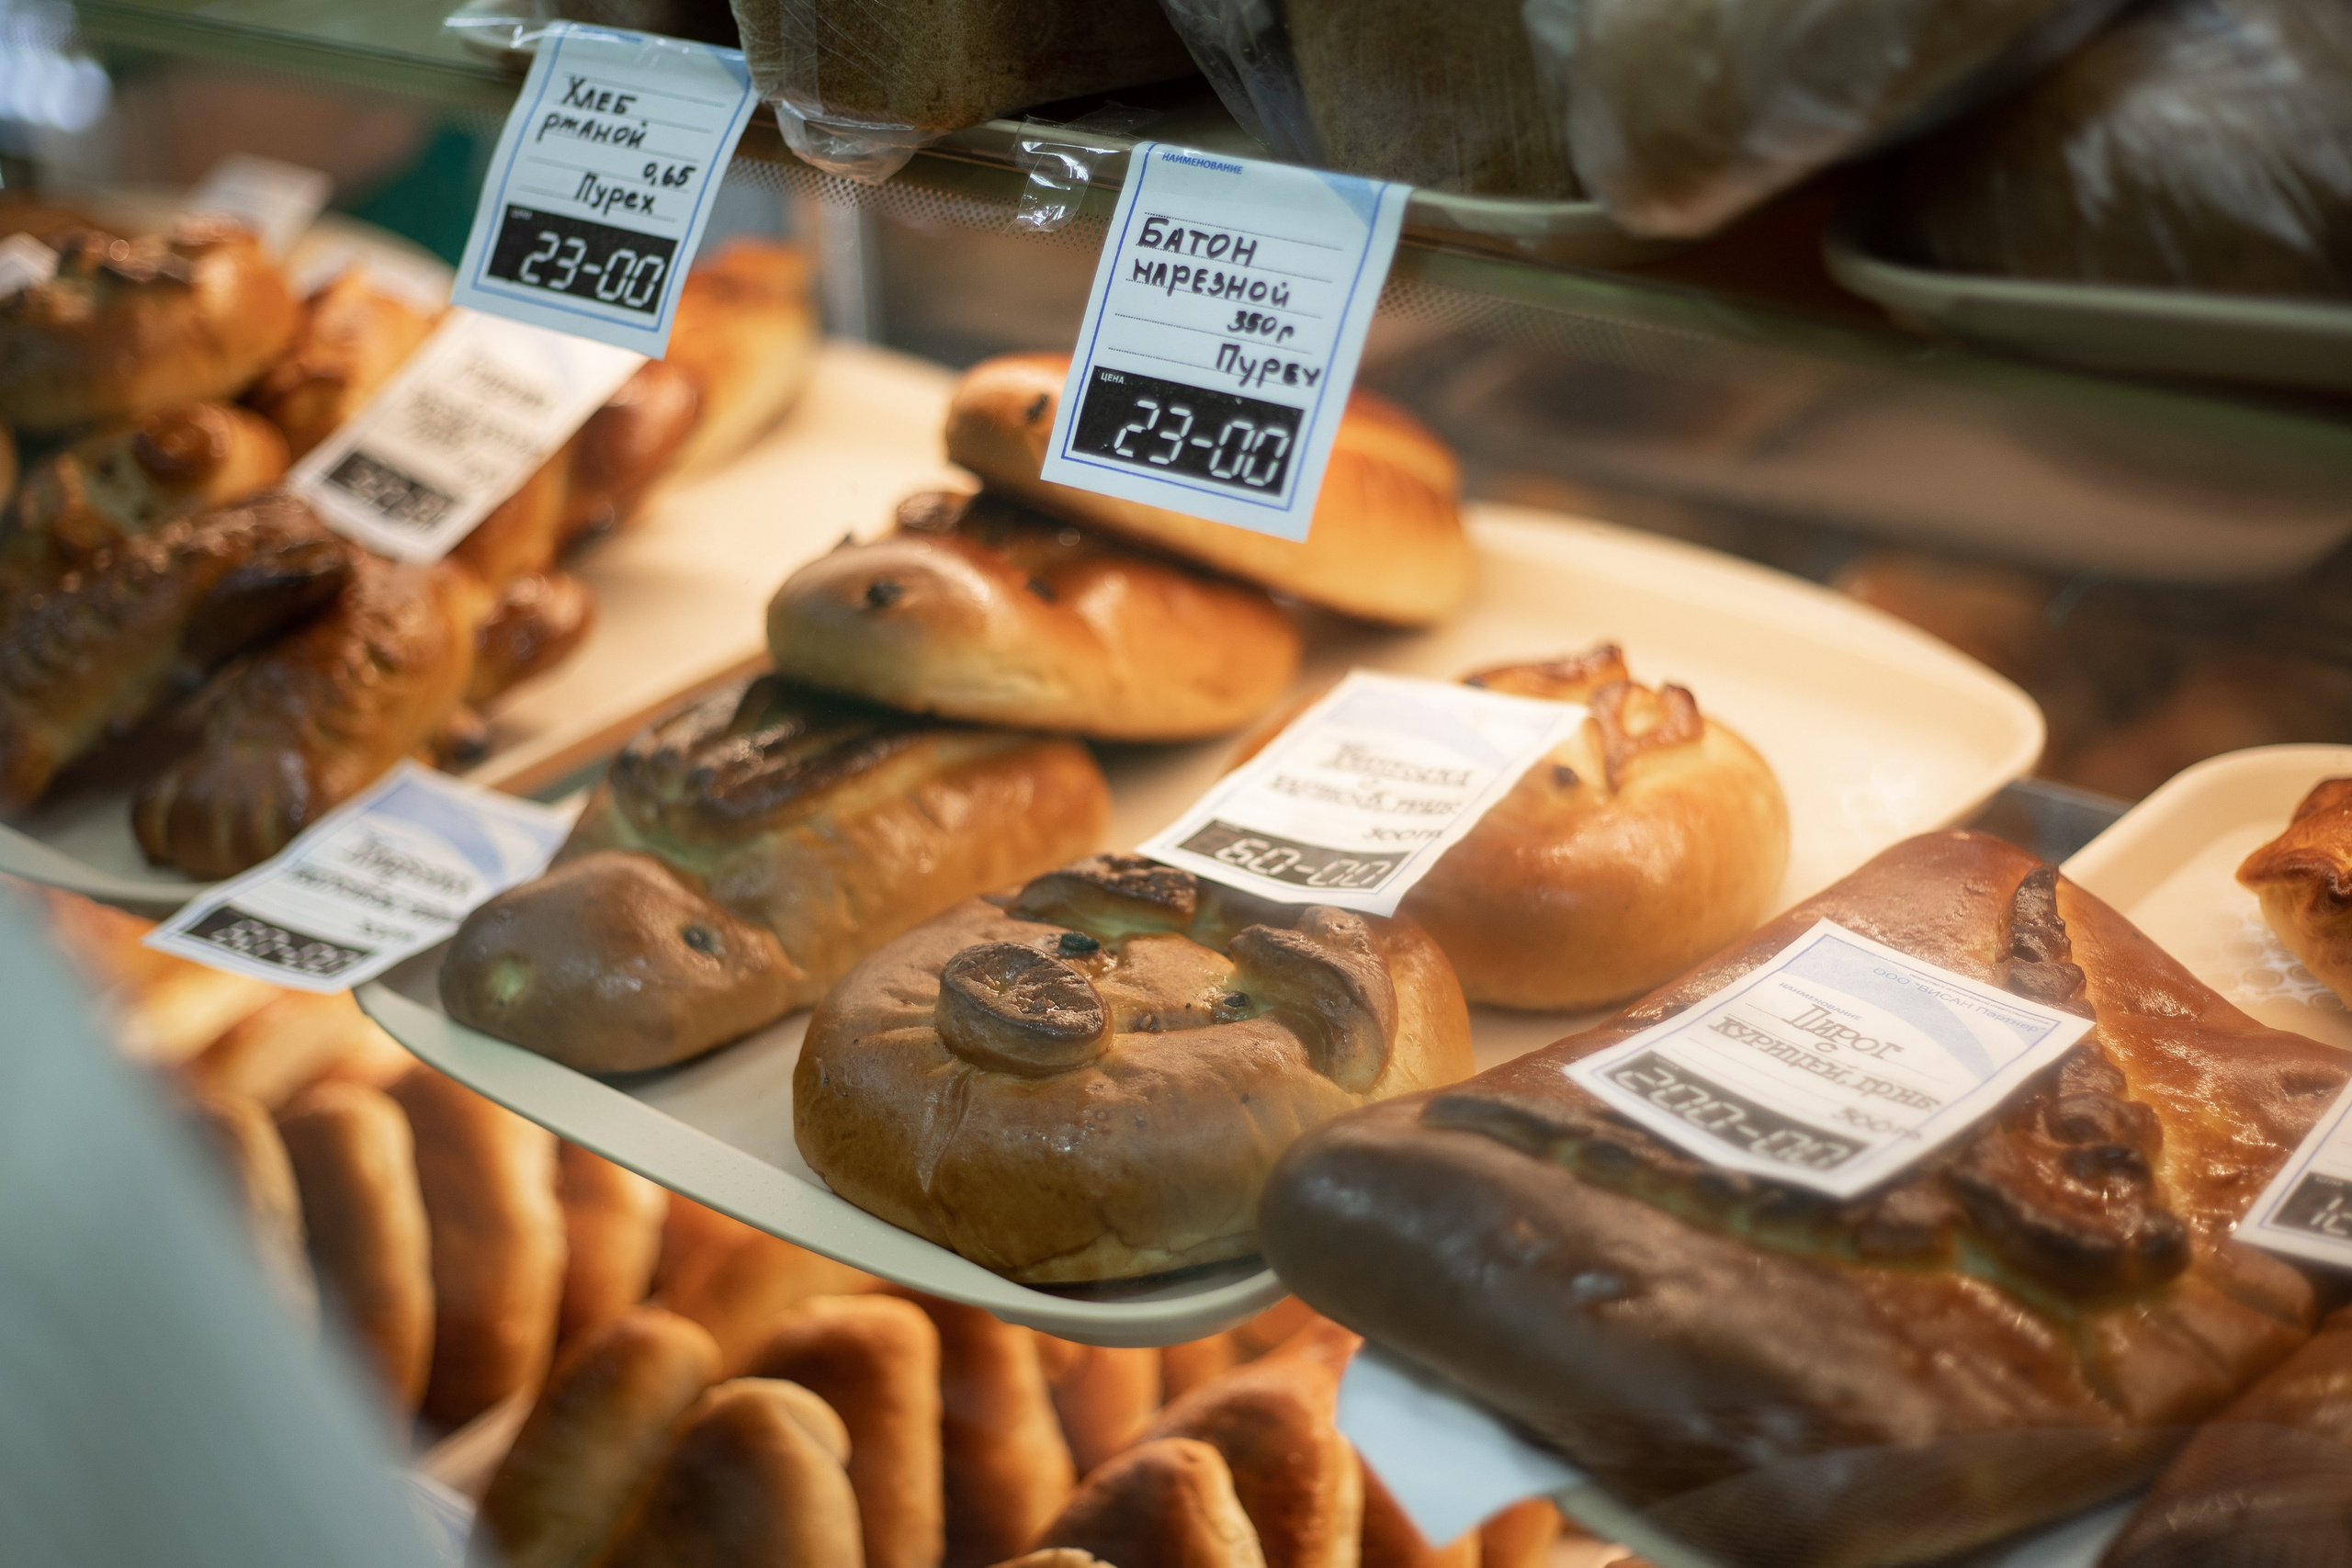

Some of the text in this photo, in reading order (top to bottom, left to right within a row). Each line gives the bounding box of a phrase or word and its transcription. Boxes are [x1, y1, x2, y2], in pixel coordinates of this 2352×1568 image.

[643, 163, 697, 187] 0,65
[1161, 152, 1244, 175] НАИМЕНОВАНИЕ
[1136, 216, 1258, 267] БАТОН
[518, 230, 666, 308] 23-00
[1101, 372, 1125, 385] ЦЕНА
[1114, 400, 1290, 487] 23-00
[1215, 837, 1393, 887] 60-00
[1872, 967, 1911, 986] ООО
[1779, 981, 1862, 1022] НАИМЕНОВАНИЕ
[1614, 1066, 1851, 1170] 200-00
